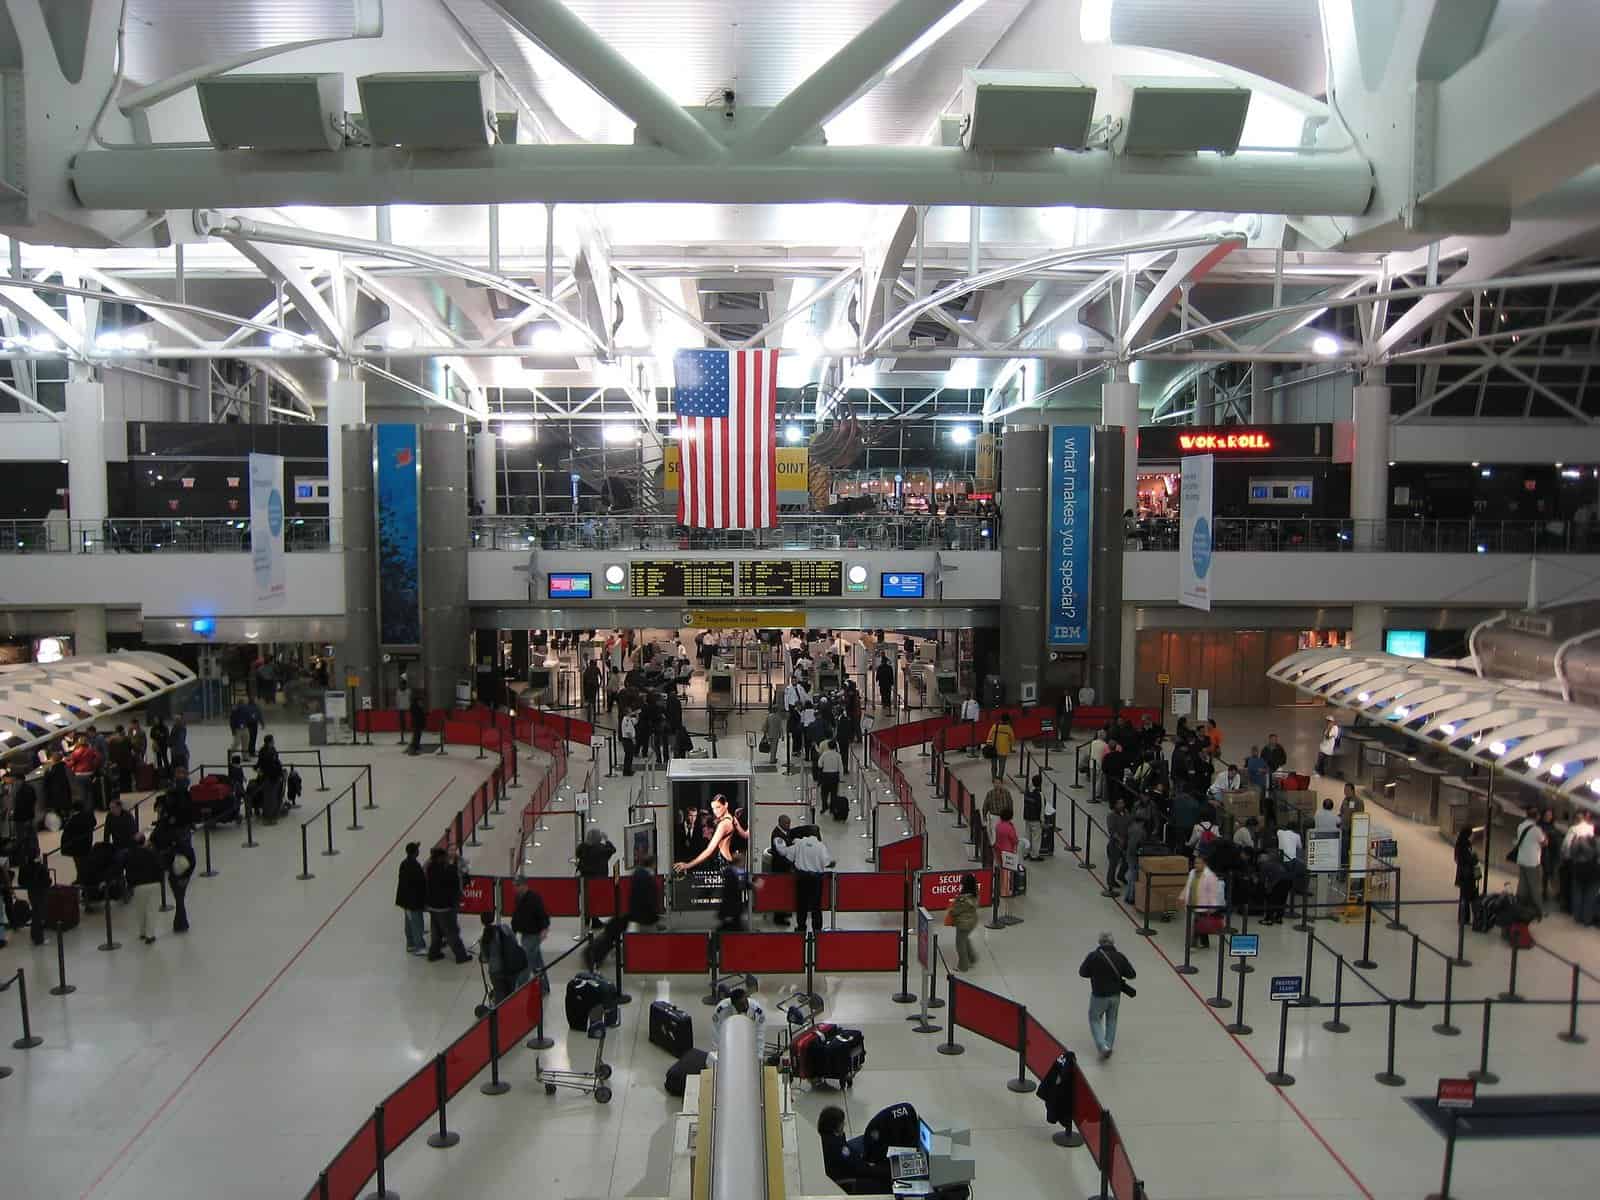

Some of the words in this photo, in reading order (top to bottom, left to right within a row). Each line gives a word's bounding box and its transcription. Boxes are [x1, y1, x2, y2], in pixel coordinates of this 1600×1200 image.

[1179, 435, 1217, 449] WOK
[1062, 437, 1076, 473] what
[1062, 475, 1077, 526] makes
[1059, 528, 1074, 557] you
[1059, 559, 1076, 619] special?
[1054, 626, 1081, 639] IBM
[463, 889, 483, 899] OINT
[891, 1107, 909, 1119] TSA
